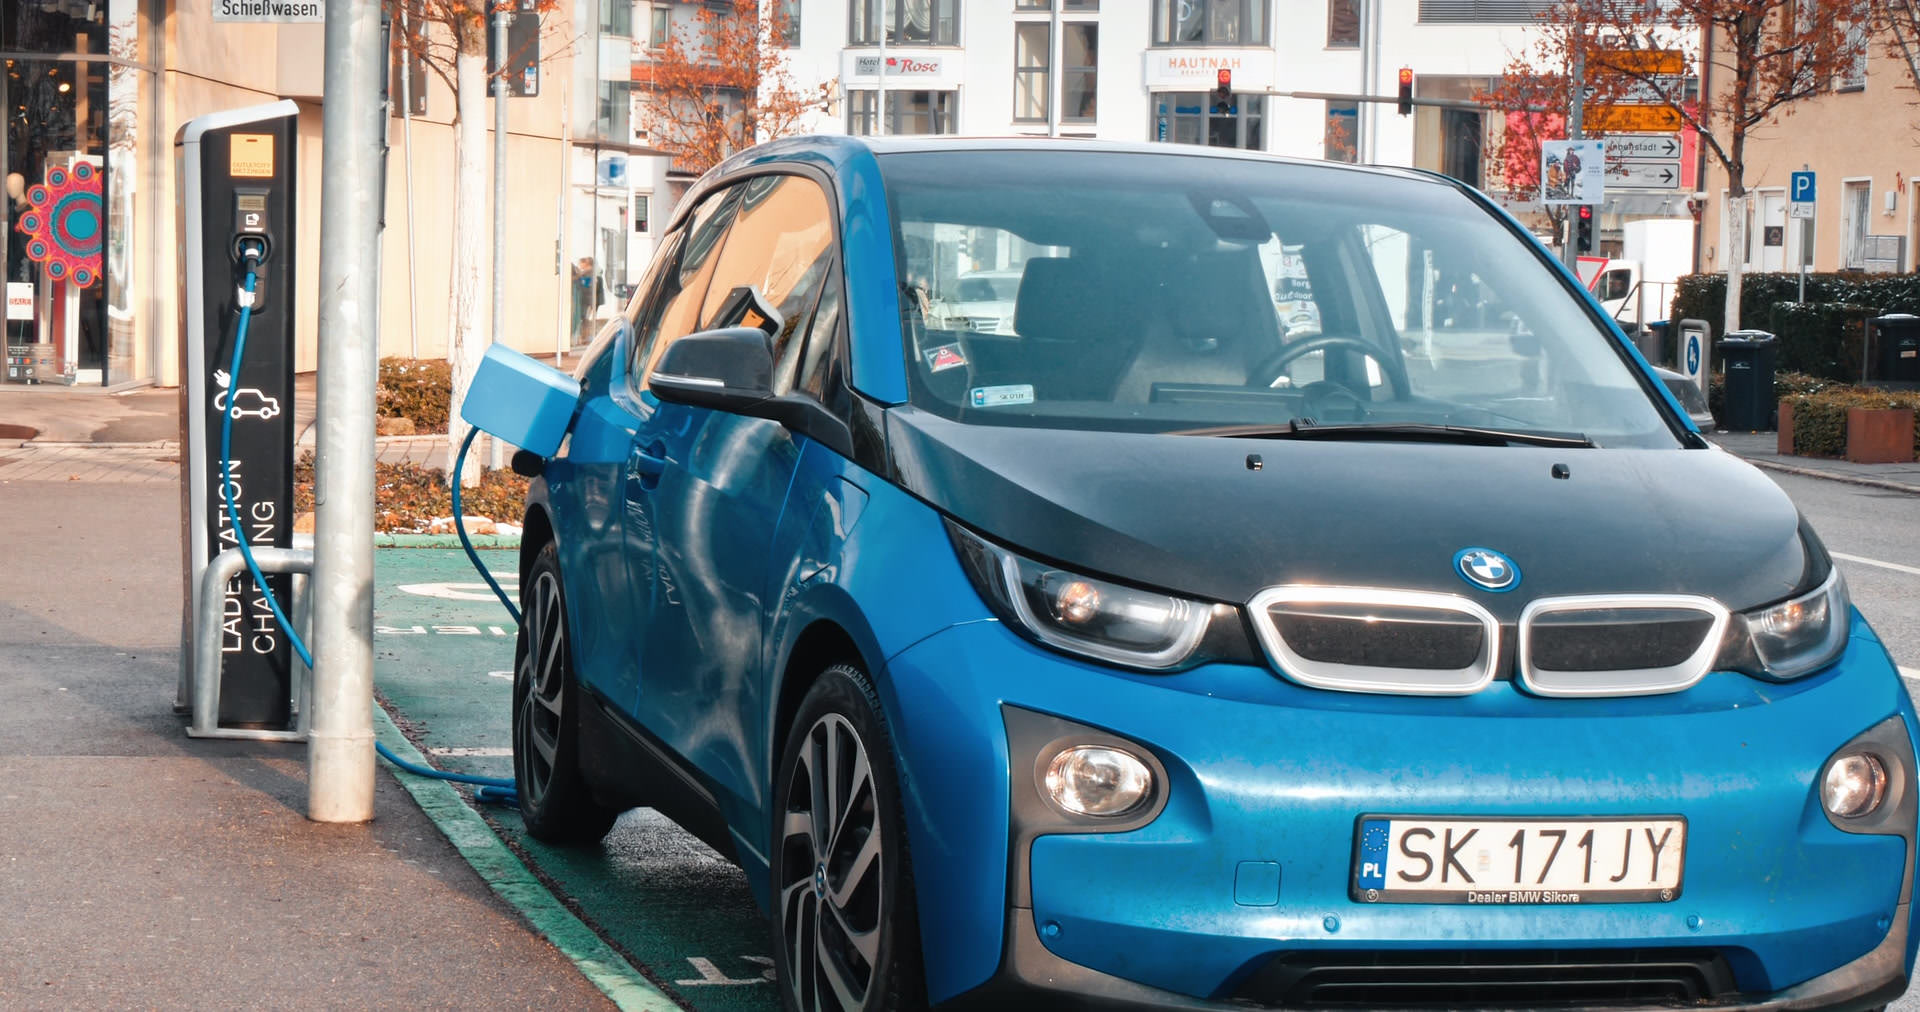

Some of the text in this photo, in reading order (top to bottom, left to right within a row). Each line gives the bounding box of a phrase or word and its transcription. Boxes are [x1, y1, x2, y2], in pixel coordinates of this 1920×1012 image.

[222, 0, 317, 16] Schießwasen
[901, 58, 939, 74] Rose
[1168, 58, 1241, 69] HAUTNAH
[1796, 175, 1810, 200] P
[219, 459, 242, 652] LADEATION
[252, 501, 275, 654] CHARNG
[1397, 827, 1673, 884] SK 171JY
[1362, 862, 1383, 878] PL
[1468, 891, 1580, 903] Dealer BMW Sikora
